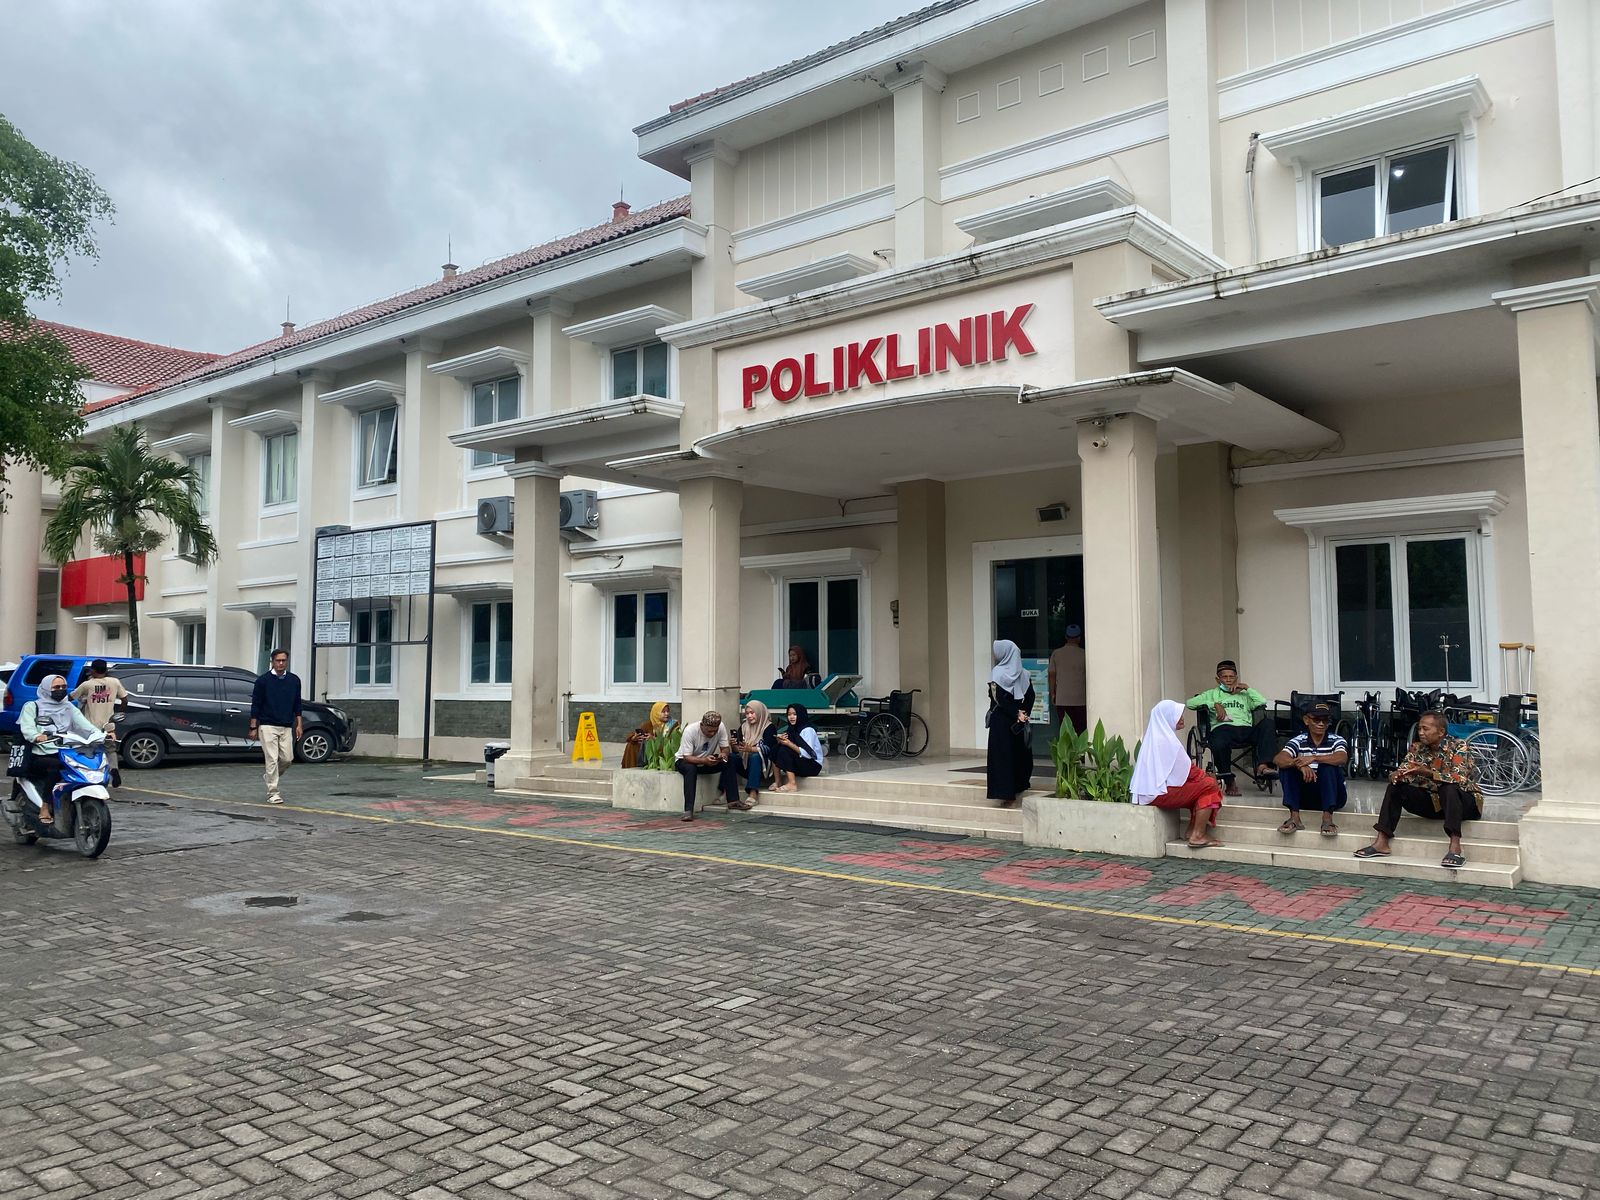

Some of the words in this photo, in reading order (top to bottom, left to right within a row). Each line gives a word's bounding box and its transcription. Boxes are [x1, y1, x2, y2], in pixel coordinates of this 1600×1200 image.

[742, 303, 1037, 410] POLIKLINIK
[1219, 699, 1245, 710] enite
[824, 840, 1570, 946] ZONE
